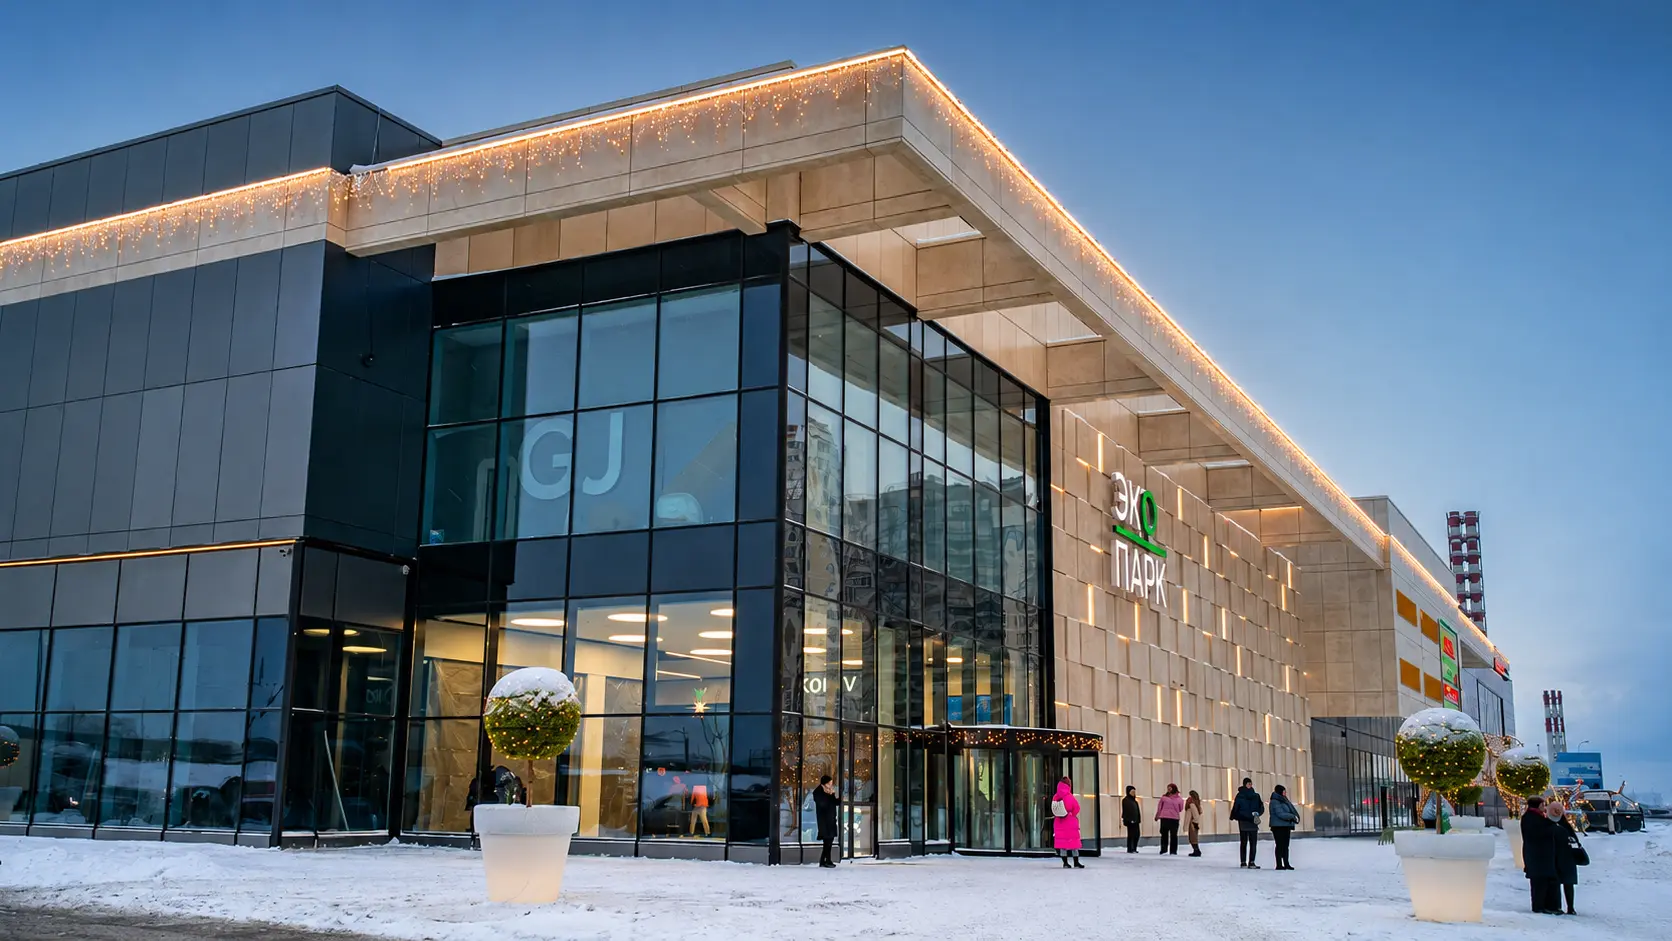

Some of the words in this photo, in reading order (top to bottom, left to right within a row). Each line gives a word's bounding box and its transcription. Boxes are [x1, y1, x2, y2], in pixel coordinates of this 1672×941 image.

[519, 412, 624, 500] GJ
[1111, 471, 1158, 537] ЭКО
[1112, 539, 1167, 608] ПАРК
